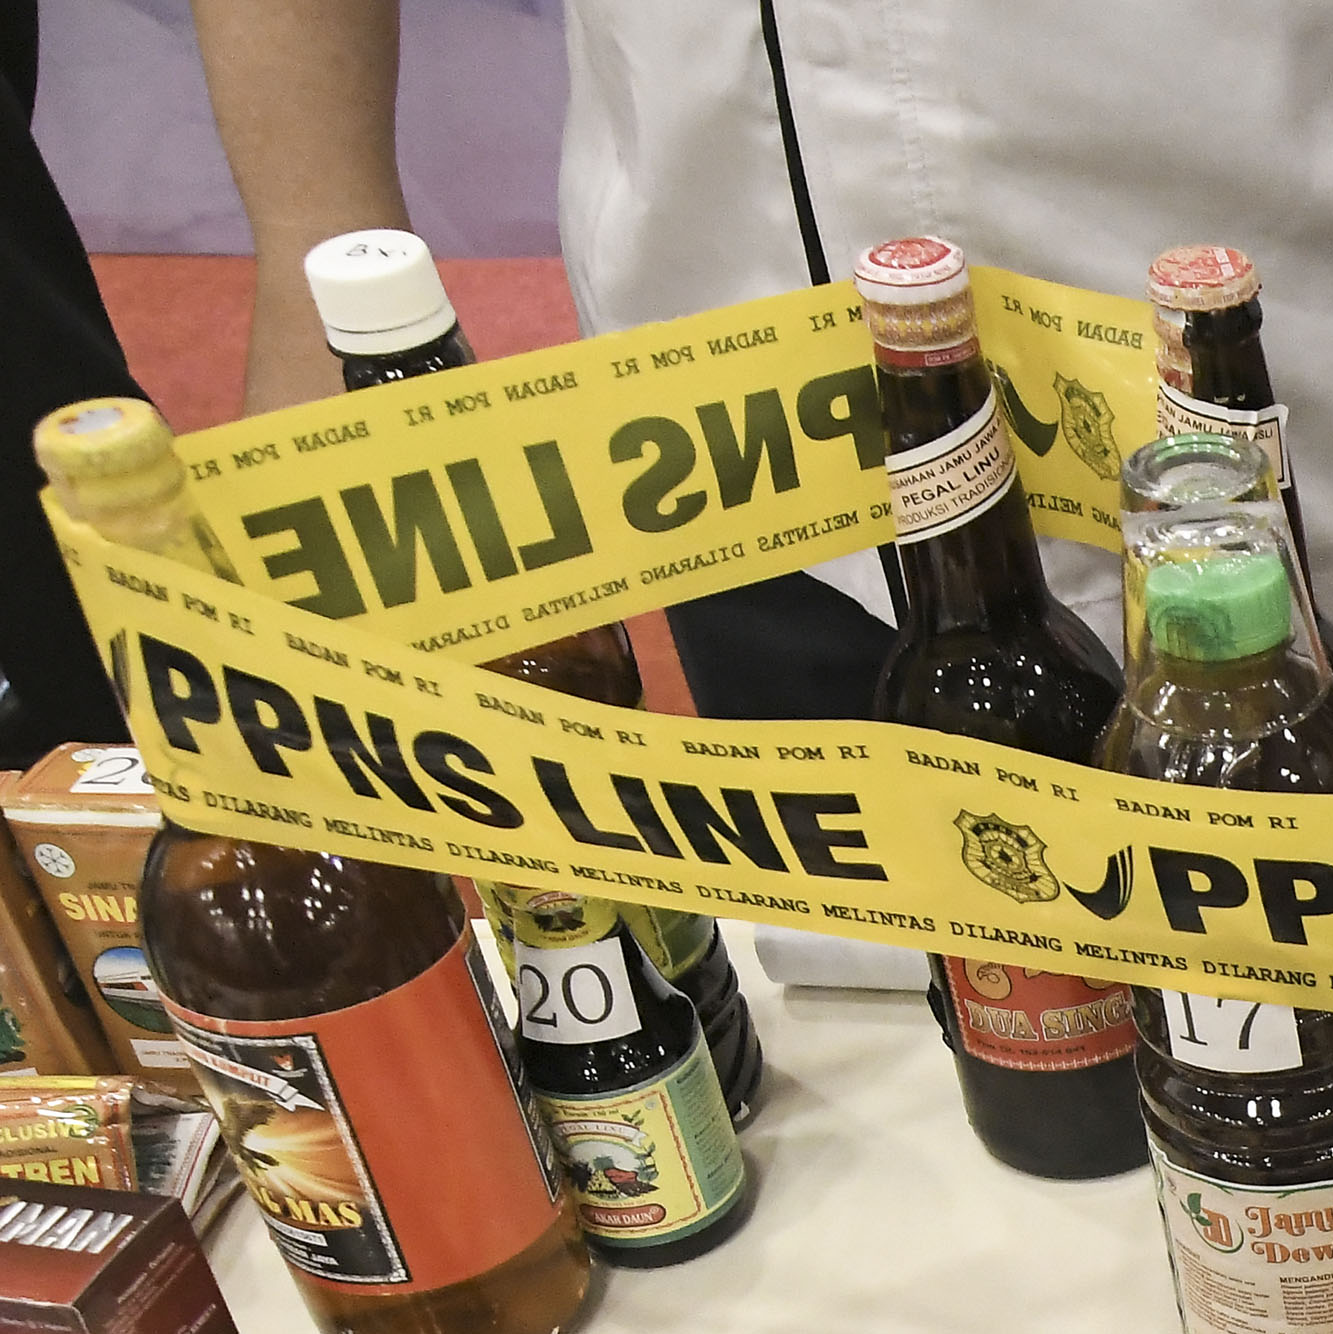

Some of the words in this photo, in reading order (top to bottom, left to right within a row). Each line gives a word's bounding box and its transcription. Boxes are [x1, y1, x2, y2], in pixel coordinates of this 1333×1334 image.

[939, 450, 972, 475] JAMU
[975, 426, 998, 454] JAWA
[902, 480, 961, 508] PEGAL
[963, 447, 999, 482] LINU
[138, 631, 525, 829] PPNS
[532, 756, 888, 881] LINE
[682, 741, 760, 759] BADAN
[777, 747, 826, 761] POM
[840, 746, 870, 759] RI
[203, 791, 312, 828] DILARANG
[324, 817, 435, 852] MELINTAS
[1076, 942, 1188, 971] MELINTAS
[1203, 960, 1317, 988] DILARANG
[519, 963, 614, 1028] 20
[964, 999, 1039, 1042] DUA
[284, 1199, 363, 1228] MAS
